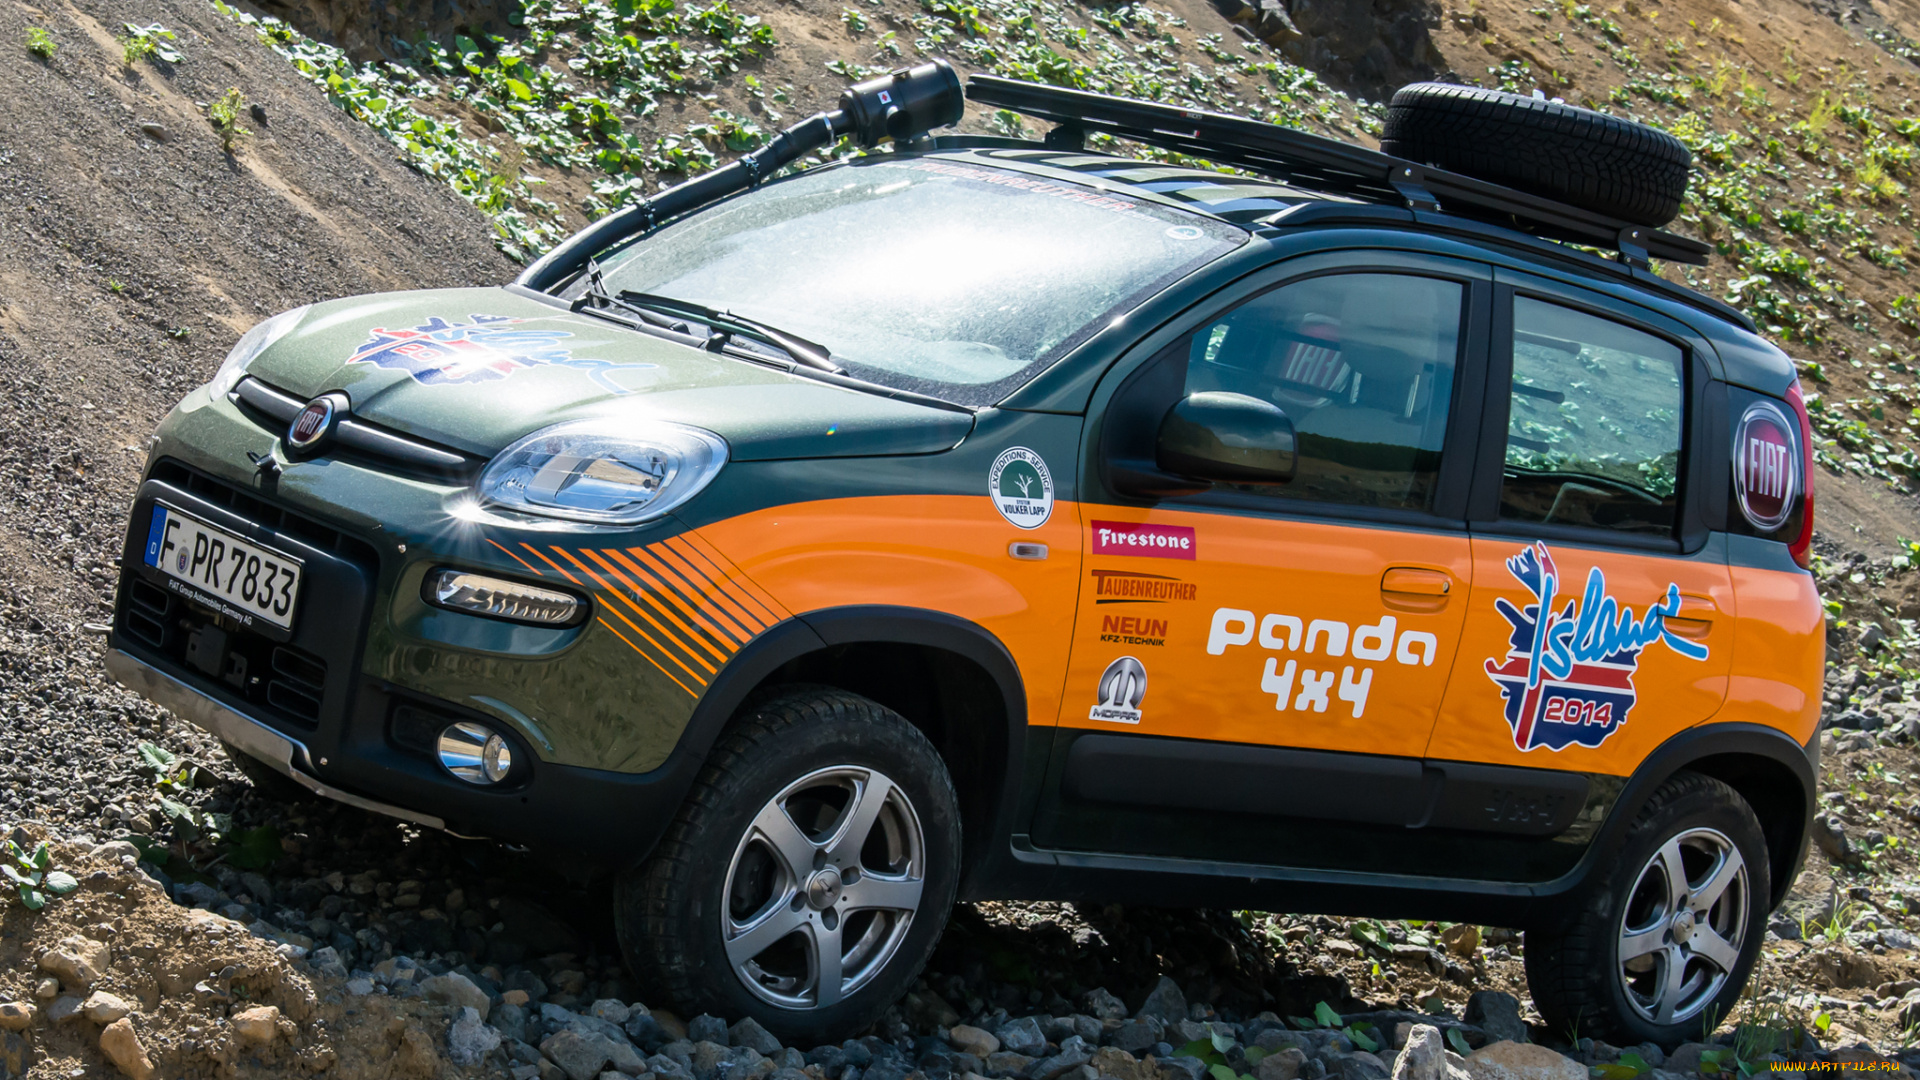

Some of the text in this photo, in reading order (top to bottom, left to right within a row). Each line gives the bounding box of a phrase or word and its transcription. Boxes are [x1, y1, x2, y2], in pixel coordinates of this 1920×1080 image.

[296, 410, 324, 435] FIAT
[1748, 437, 1786, 499] FIAT
[1003, 504, 1046, 516] VOLKER LAPP
[150, 541, 157, 555] D
[160, 518, 181, 562] F
[1099, 528, 1190, 549] Firestone
[1091, 569, 1197, 601] TAUBENREUTHER
[168, 579, 253, 626] FIAT Group Automobiles Germany AG
[1100, 634, 1165, 647] KFZ-TECHNIK
[1102, 615, 1168, 637] NEUN
[1206, 607, 1437, 667] panda
[1260, 657, 1373, 718] 4x4
[1543, 697, 1612, 727] 2014
